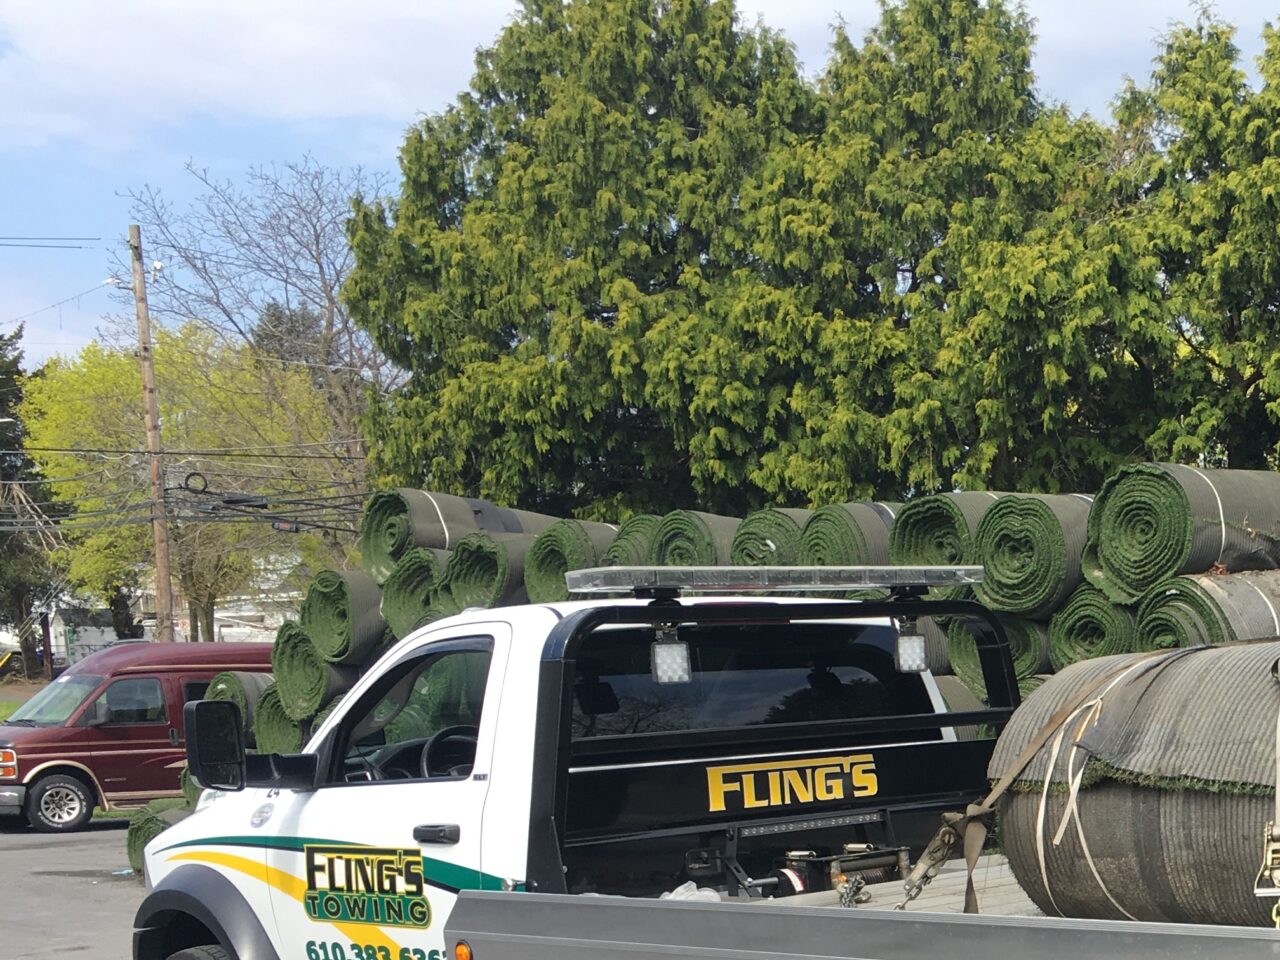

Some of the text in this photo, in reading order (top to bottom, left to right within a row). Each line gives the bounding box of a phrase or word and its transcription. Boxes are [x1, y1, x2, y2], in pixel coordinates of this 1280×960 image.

[705, 753, 879, 812] FLING'S
[304, 844, 424, 896] FLING'S
[306, 895, 429, 924] TOWING
